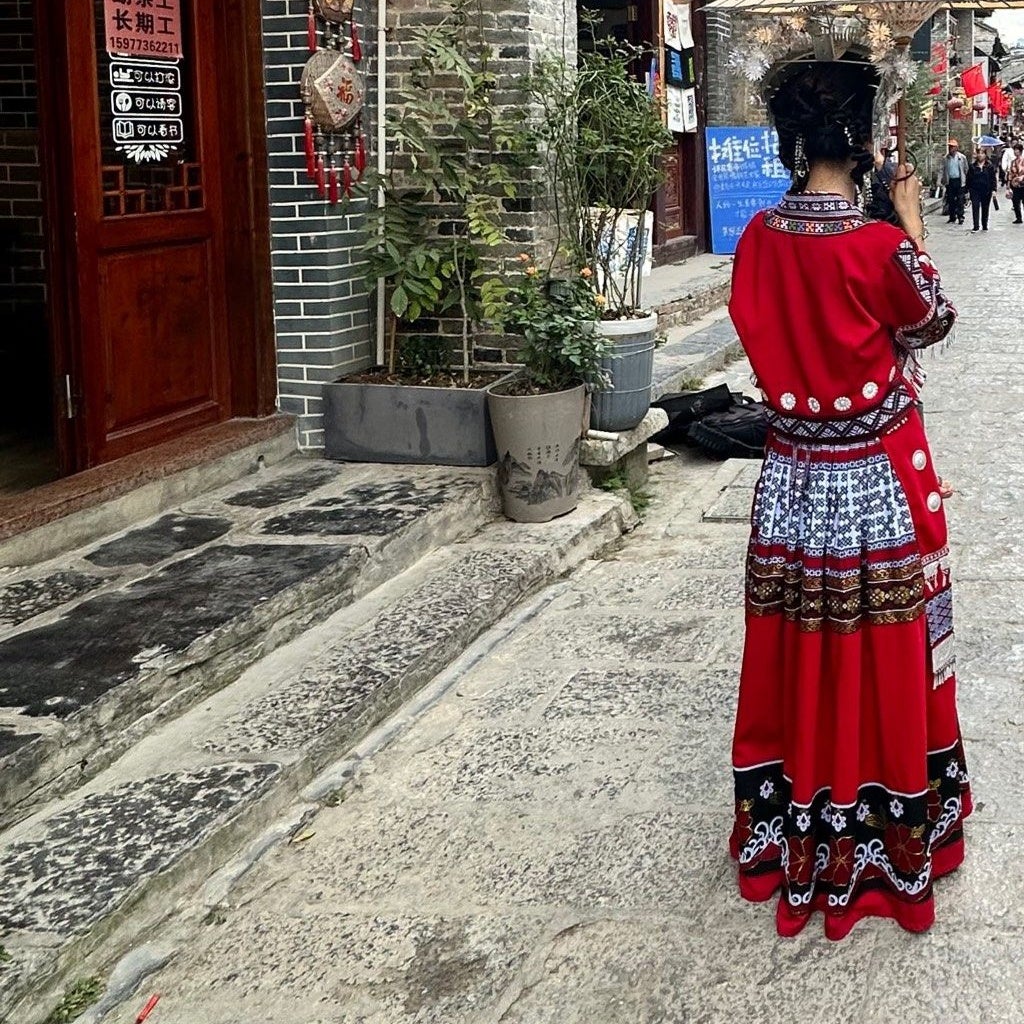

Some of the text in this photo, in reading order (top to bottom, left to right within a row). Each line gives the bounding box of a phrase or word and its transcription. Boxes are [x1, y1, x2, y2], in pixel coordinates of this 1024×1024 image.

[112, 8, 175, 35] 长期工
[109, 36, 179, 54] 15977362211
[336, 77, 355, 105] 福
